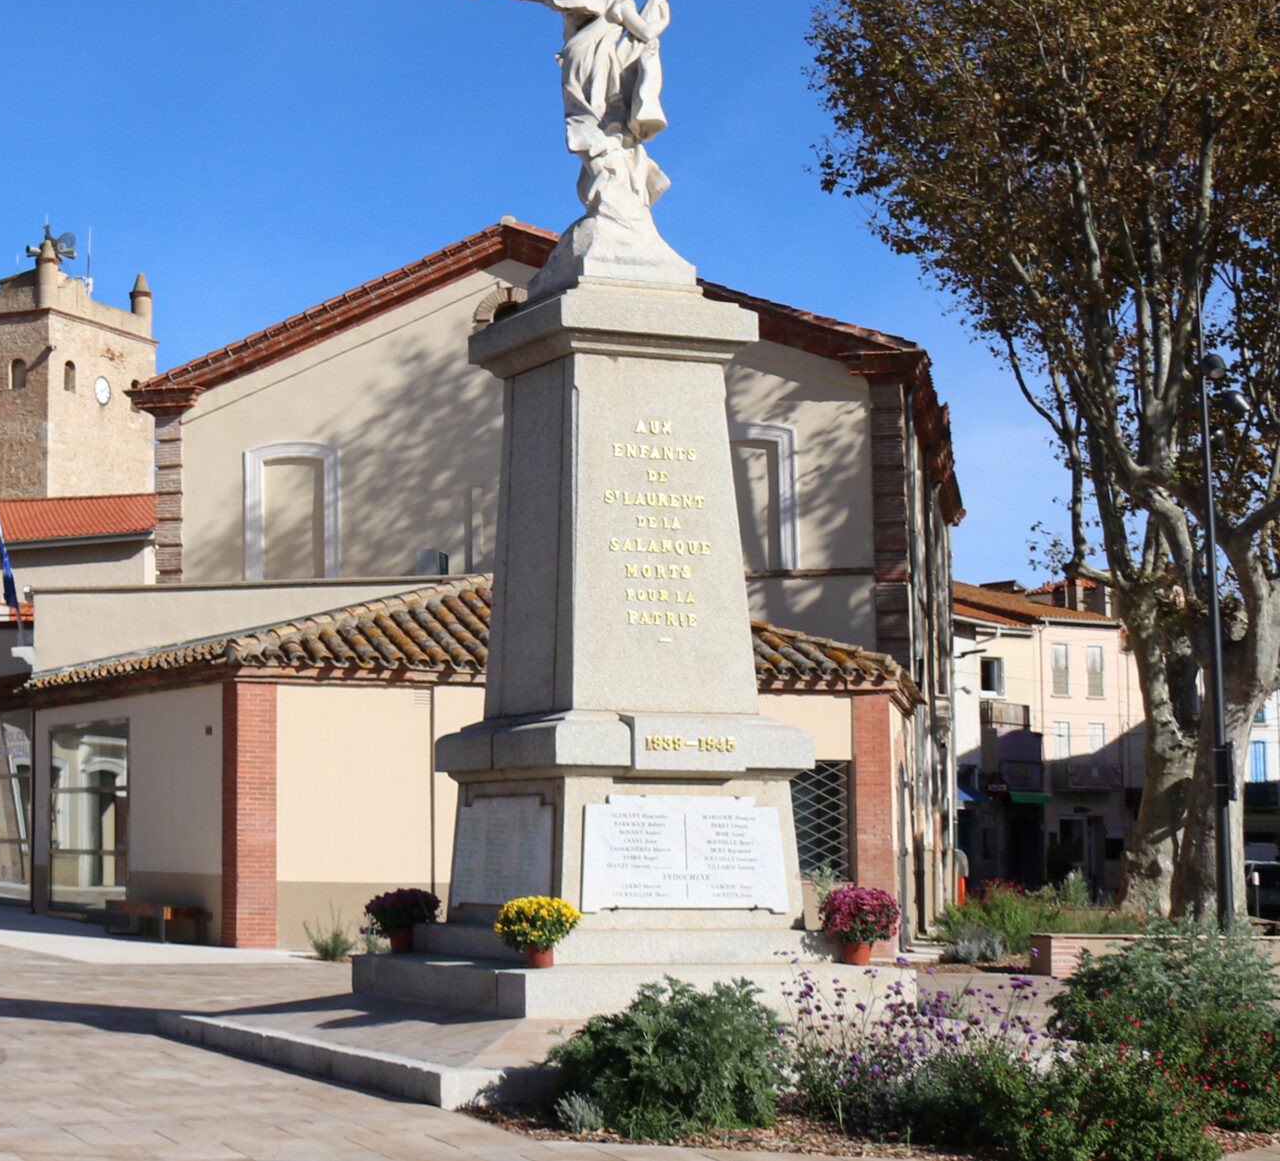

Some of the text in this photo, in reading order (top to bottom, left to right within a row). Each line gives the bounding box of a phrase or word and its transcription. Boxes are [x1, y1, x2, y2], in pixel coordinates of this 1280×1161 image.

[634, 419, 672, 435] AUX
[612, 443, 697, 462] ENFANTS
[647, 469, 669, 483] DE
[622, 491, 705, 509] LAURENT
[636, 515, 682, 530] DE LA
[609, 537, 711, 555] SALANQUE
[624, 563, 692, 579] MORTS
[625, 588, 695, 604] POUR LA
[627, 610, 697, 627] PATRIE
